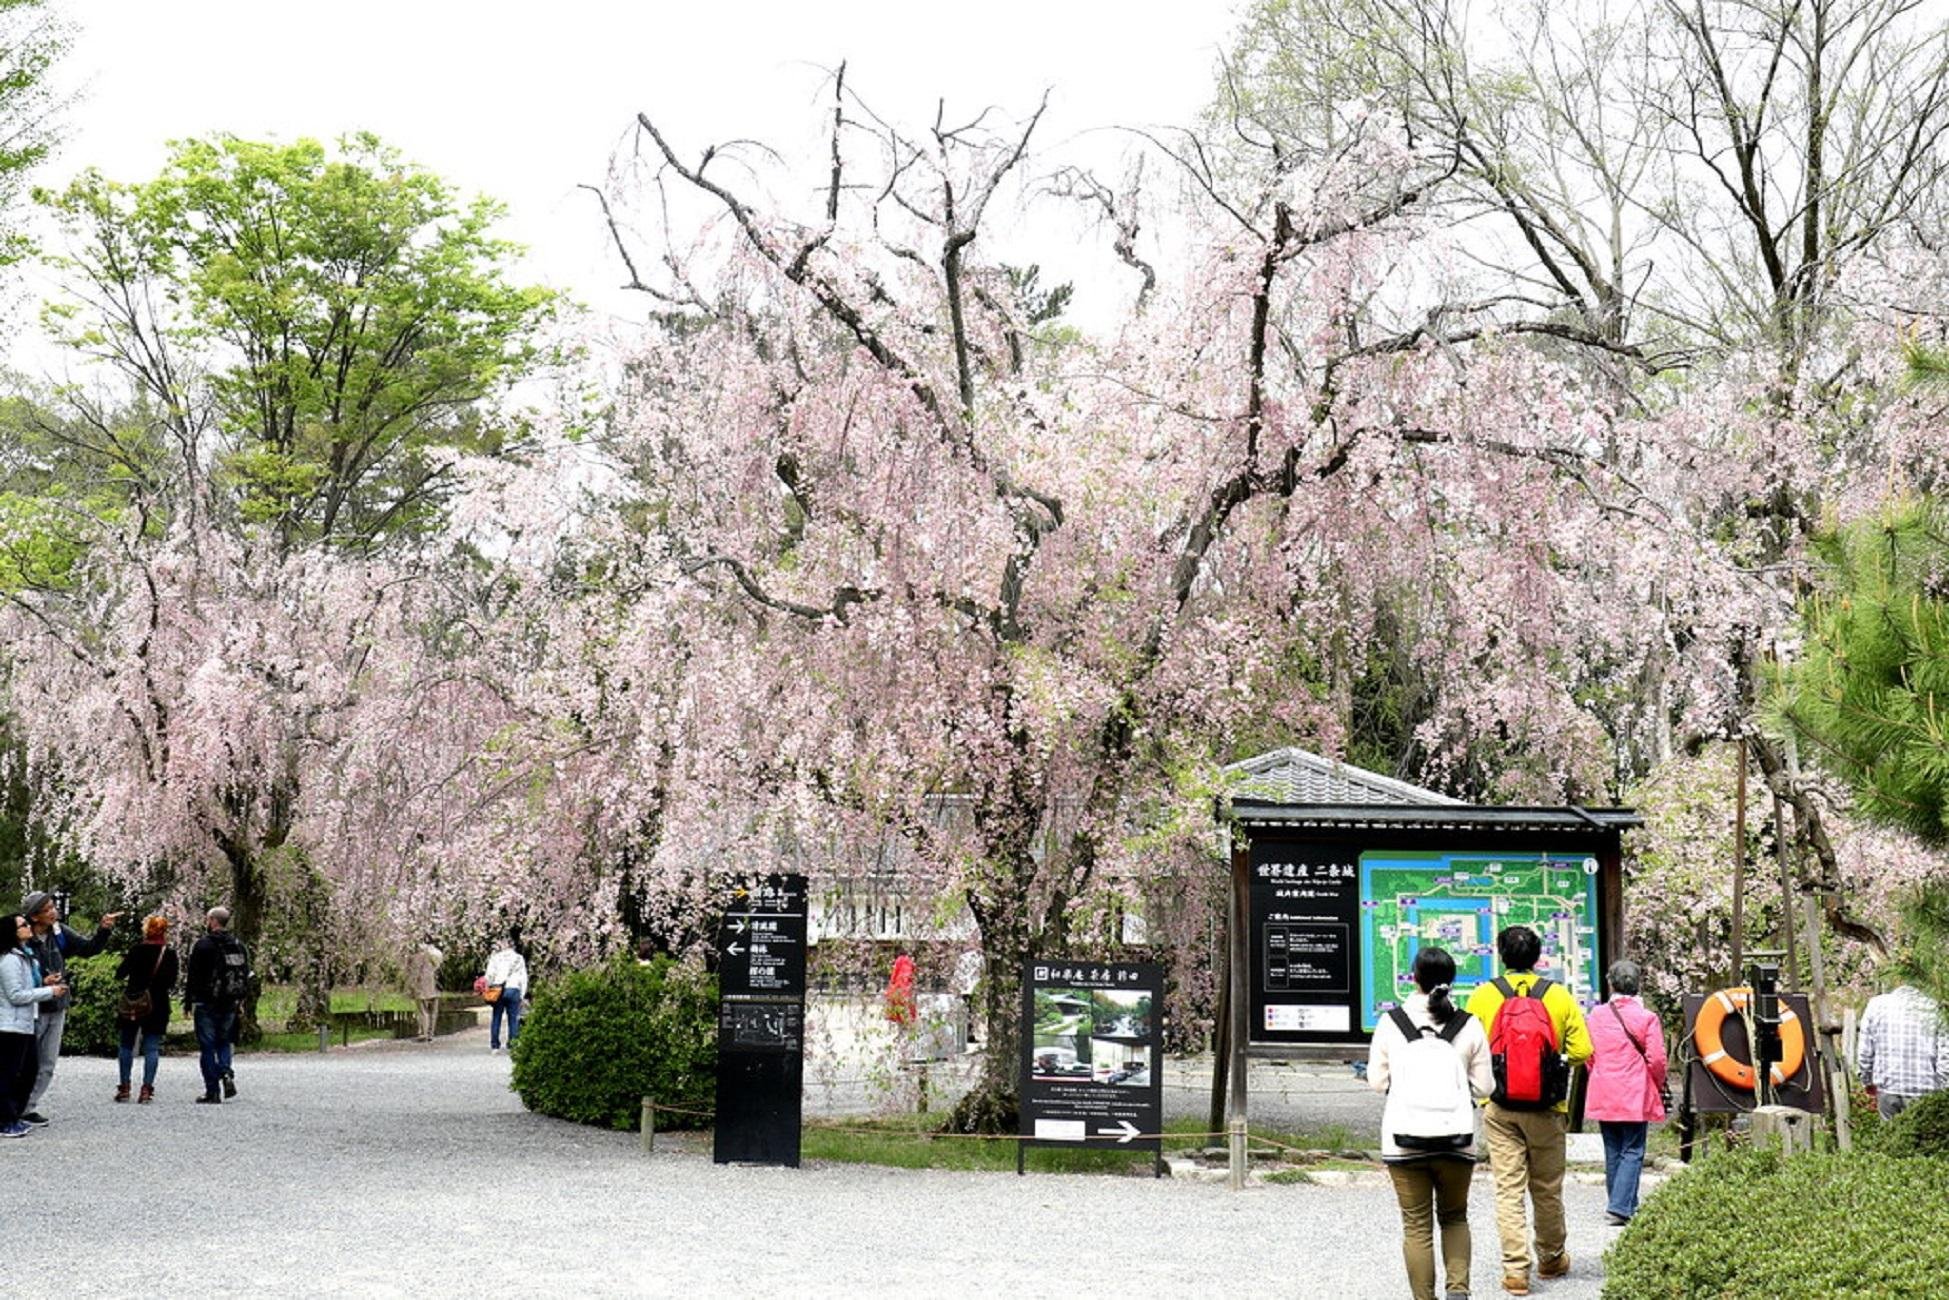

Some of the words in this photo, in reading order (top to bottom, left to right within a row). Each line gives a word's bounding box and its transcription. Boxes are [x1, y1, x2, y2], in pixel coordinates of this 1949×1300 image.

[1257, 863, 1309, 877] 世界遺産
[1314, 863, 1355, 877] 二条城
